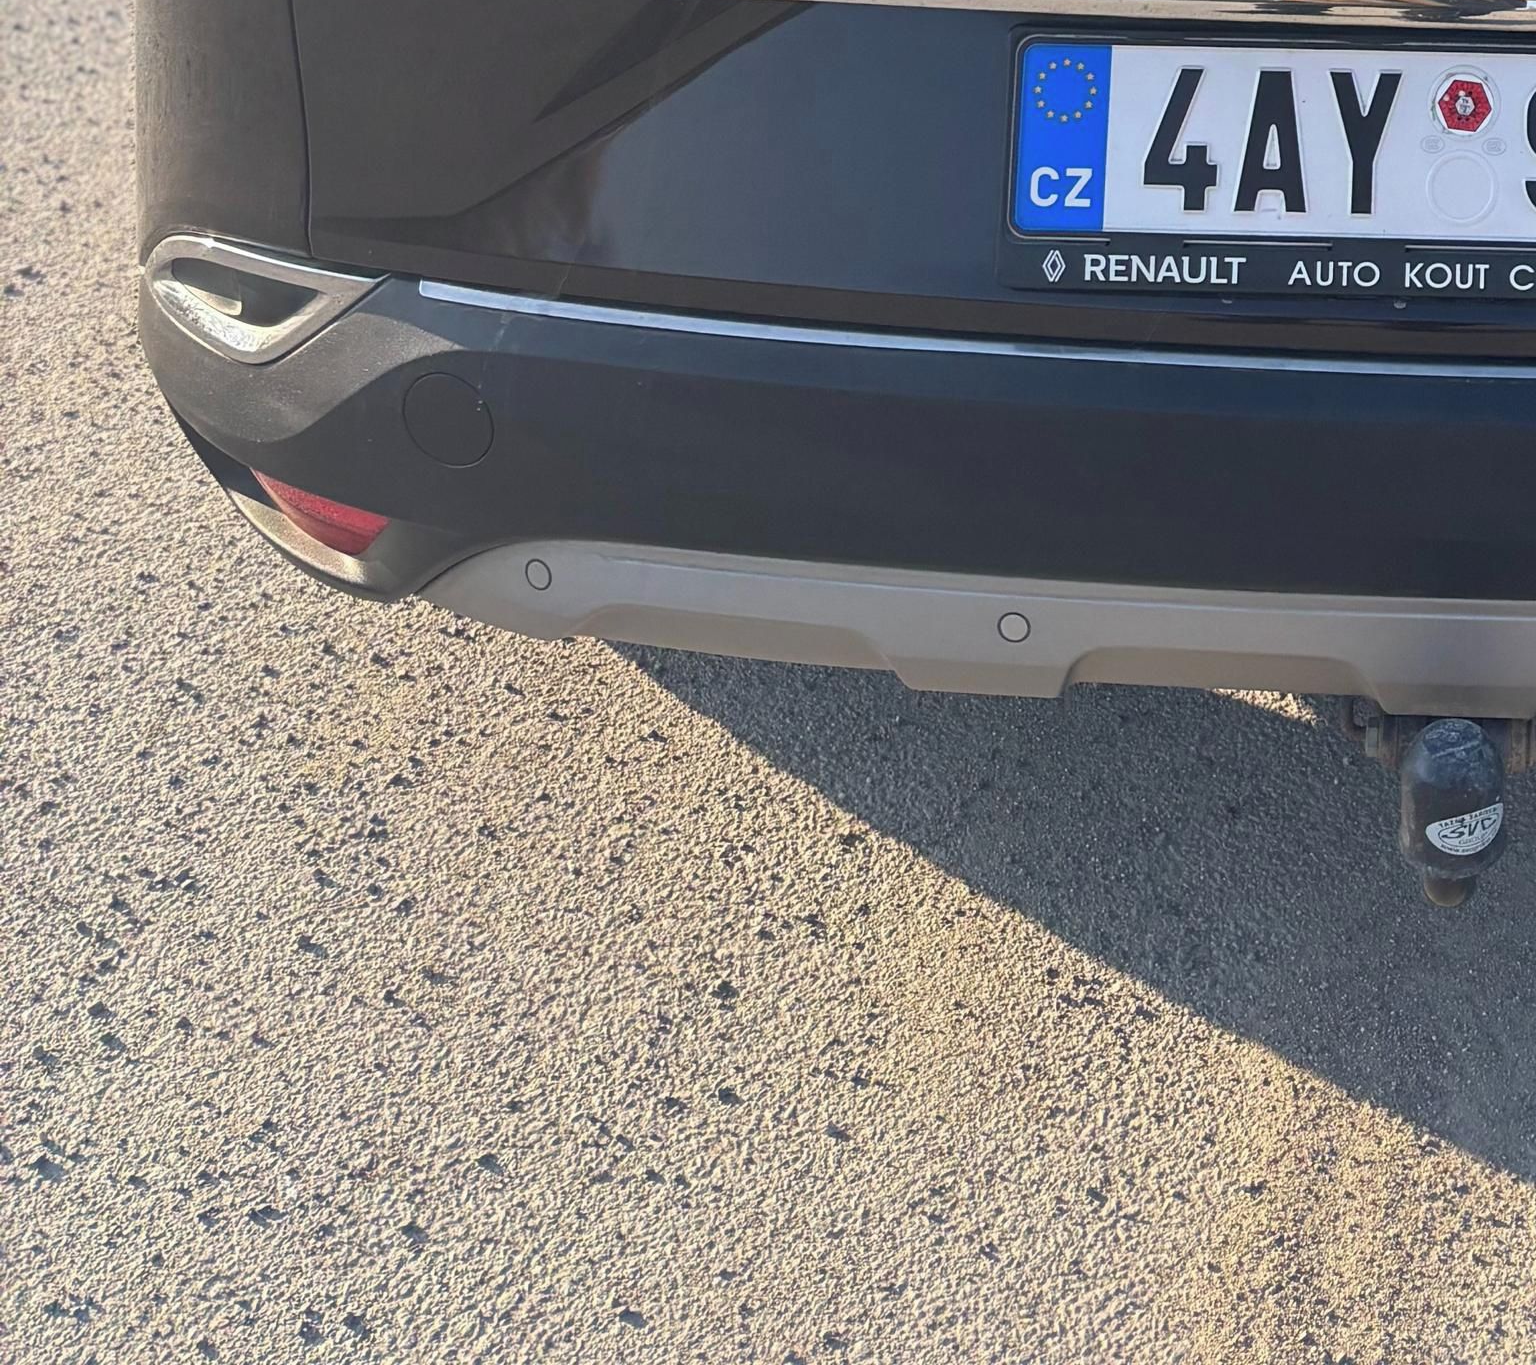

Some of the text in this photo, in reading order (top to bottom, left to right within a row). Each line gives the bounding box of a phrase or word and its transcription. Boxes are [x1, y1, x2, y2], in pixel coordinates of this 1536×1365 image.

[1143, 67, 1404, 215] 4AY
[1030, 166, 1092, 207] CZ
[1083, 253, 1247, 285] RENAULT
[1287, 260, 1381, 287] AUTO
[1404, 262, 1490, 290] KOUT
